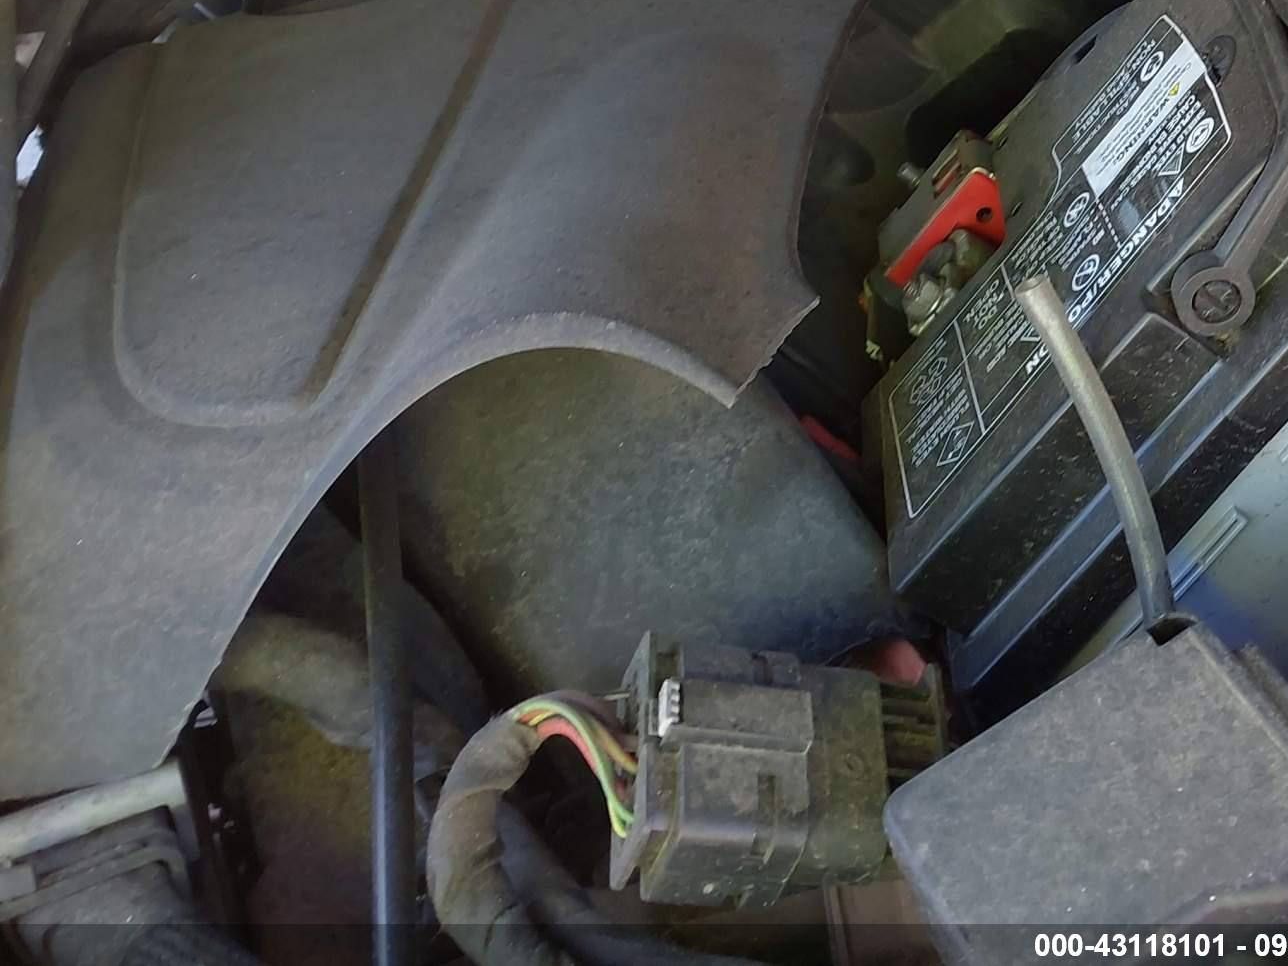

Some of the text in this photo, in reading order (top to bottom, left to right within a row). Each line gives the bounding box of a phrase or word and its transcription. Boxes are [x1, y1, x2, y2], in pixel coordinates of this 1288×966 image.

[1072, 39, 1155, 142] NON-SPILLABLE
[1164, 93, 1196, 133] CAUSE
[1112, 97, 1169, 167] WARNING:
[962, 278, 999, 323] OPEN.
[1025, 198, 1171, 374] DANGER/POON
[973, 291, 997, 327] NOT
[977, 303, 997, 331] DO
